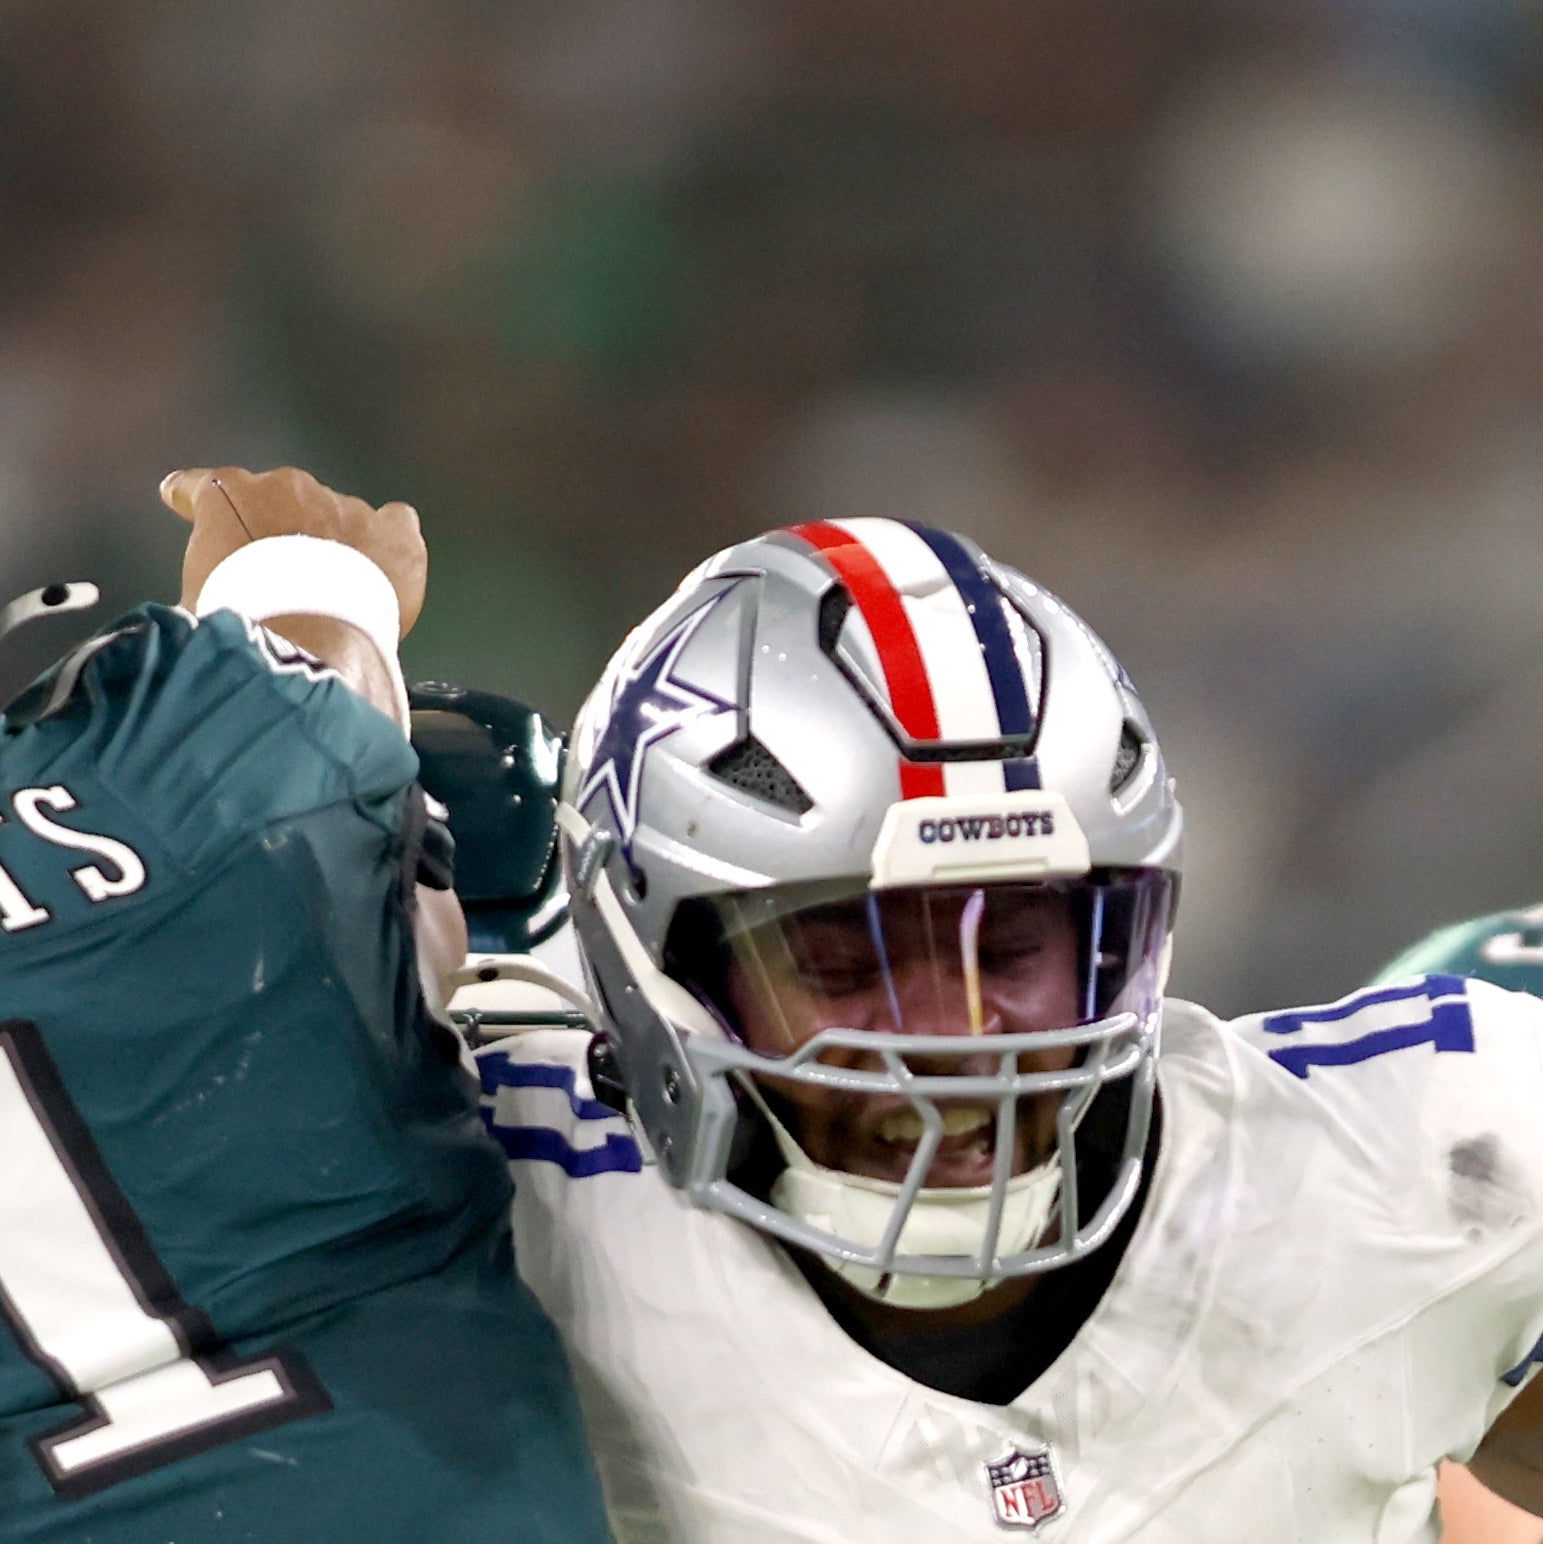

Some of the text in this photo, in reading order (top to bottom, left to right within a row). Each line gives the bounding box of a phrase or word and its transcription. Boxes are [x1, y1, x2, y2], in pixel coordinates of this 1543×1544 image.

[919, 810, 1055, 844] COWBOYS
[1262, 973, 1476, 1080] 11
[999, 1479, 1055, 1518] NFL
